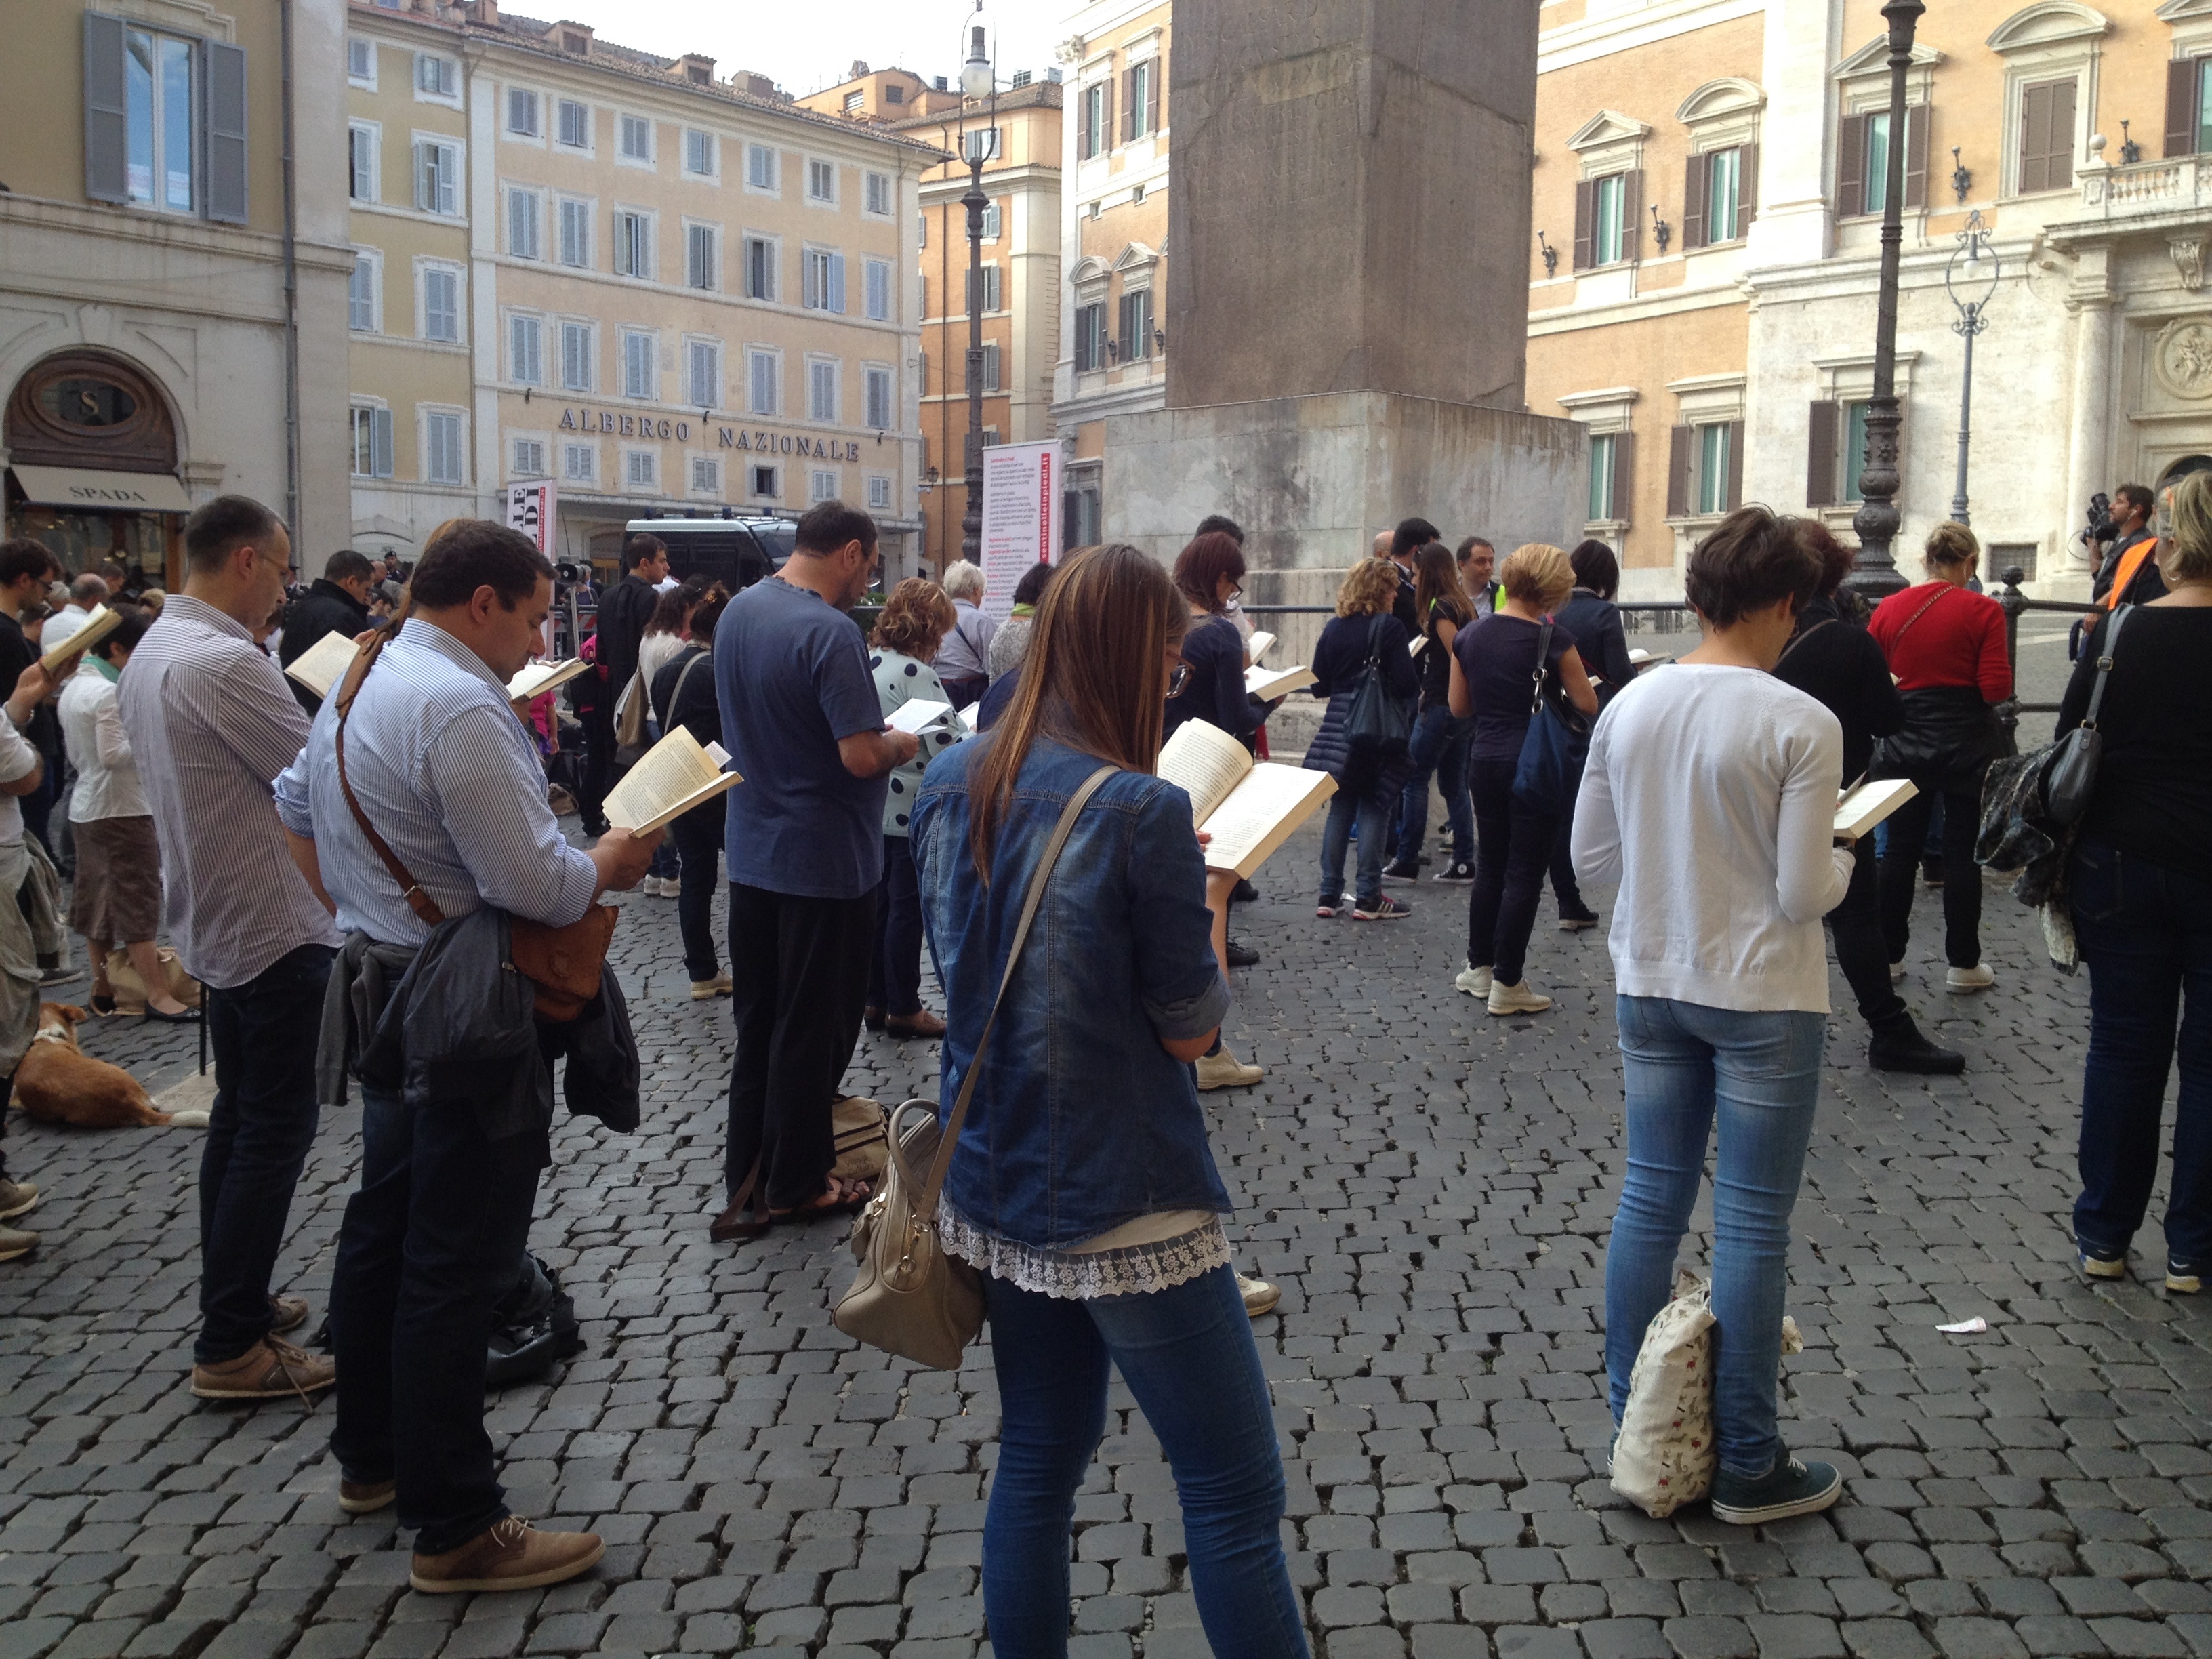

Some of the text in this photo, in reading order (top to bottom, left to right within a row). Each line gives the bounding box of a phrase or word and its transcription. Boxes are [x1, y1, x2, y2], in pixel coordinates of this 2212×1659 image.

[81, 391, 99, 415] S
[559, 408, 859, 461] ALBERGO NAZIONALE
[69, 486, 146, 502] SPADA
[513, 488, 525, 532] LE
[524, 488, 539, 546] DI
[1040, 456, 1049, 559] sentinelleinpiedi.it
